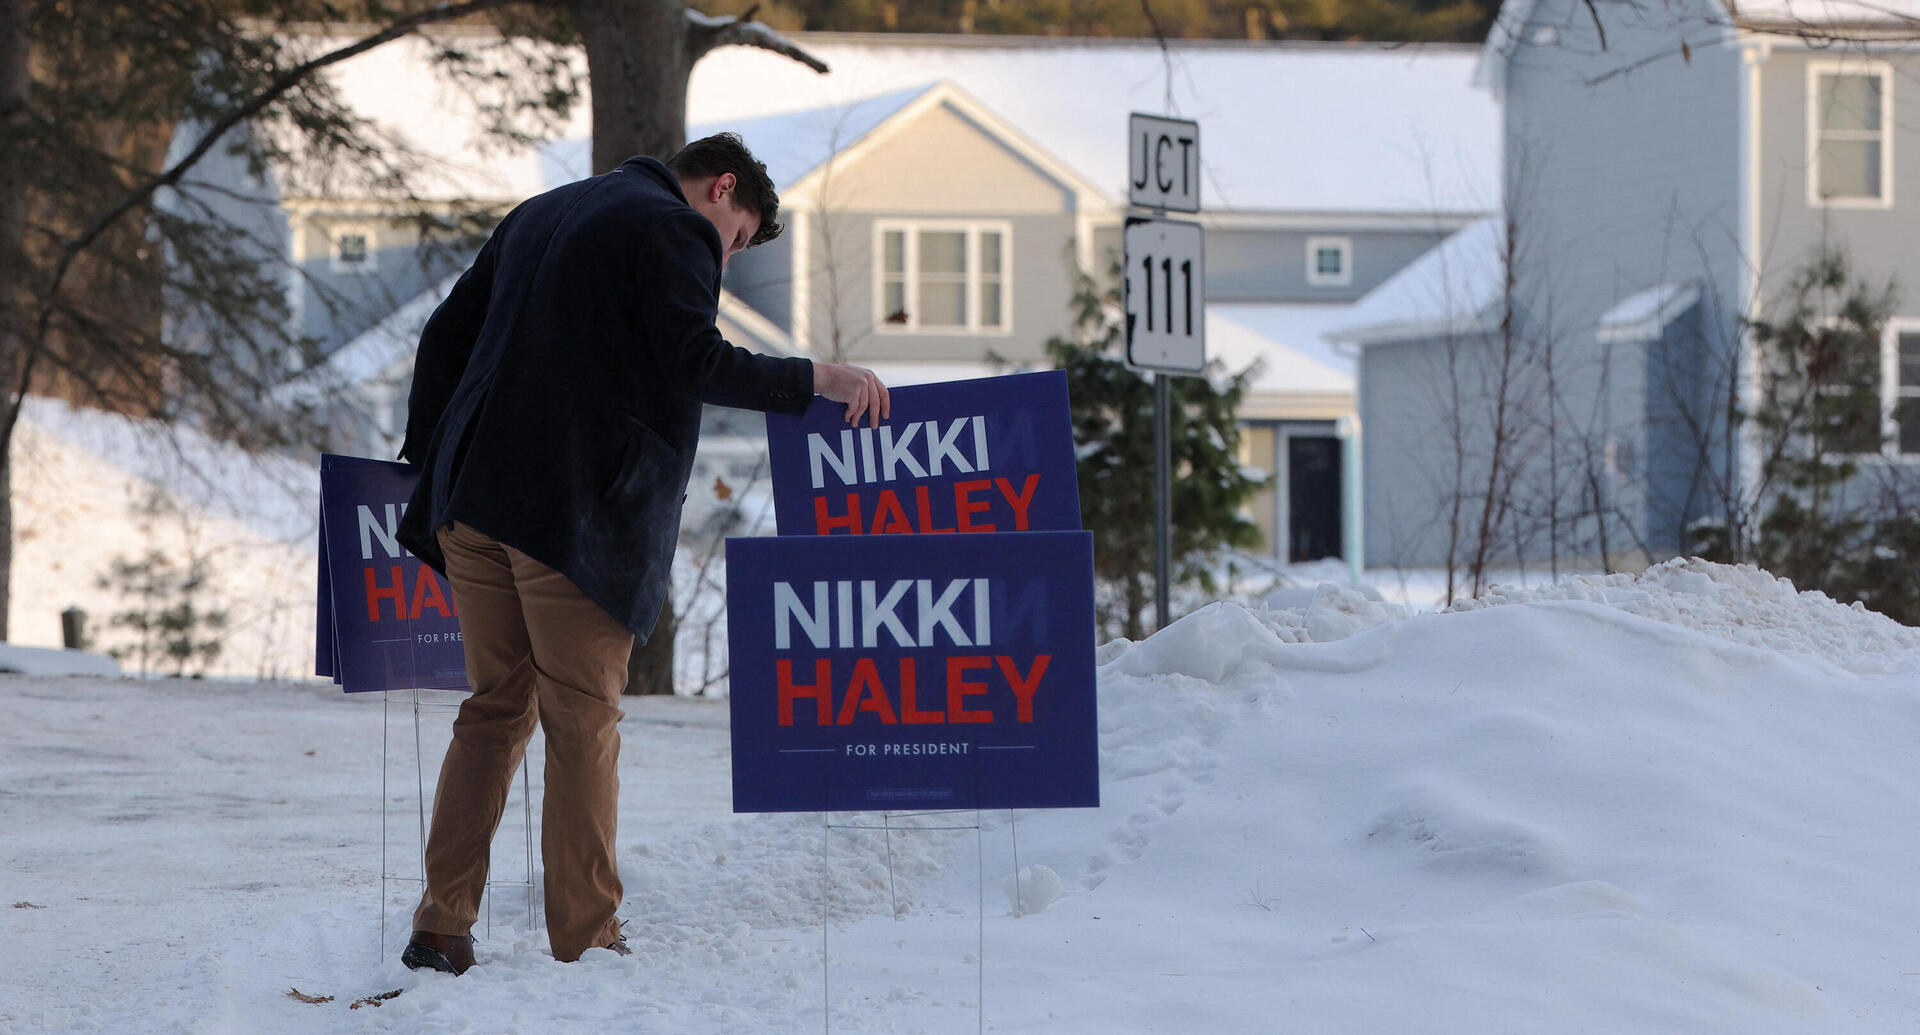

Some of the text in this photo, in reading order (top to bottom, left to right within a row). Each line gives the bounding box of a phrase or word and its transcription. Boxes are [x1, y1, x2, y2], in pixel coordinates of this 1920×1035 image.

[1134, 132, 1193, 196] JCT
[1142, 255, 1192, 336] 111
[807, 415, 990, 489] NIKKI
[813, 473, 1041, 536] HALEY
[364, 564, 459, 622] HA
[773, 578, 991, 649] NIKKI
[418, 634, 439, 644] FOR
[776, 654, 1053, 726] HALEY
[846, 742, 970, 756] FOR PRESIDENT
